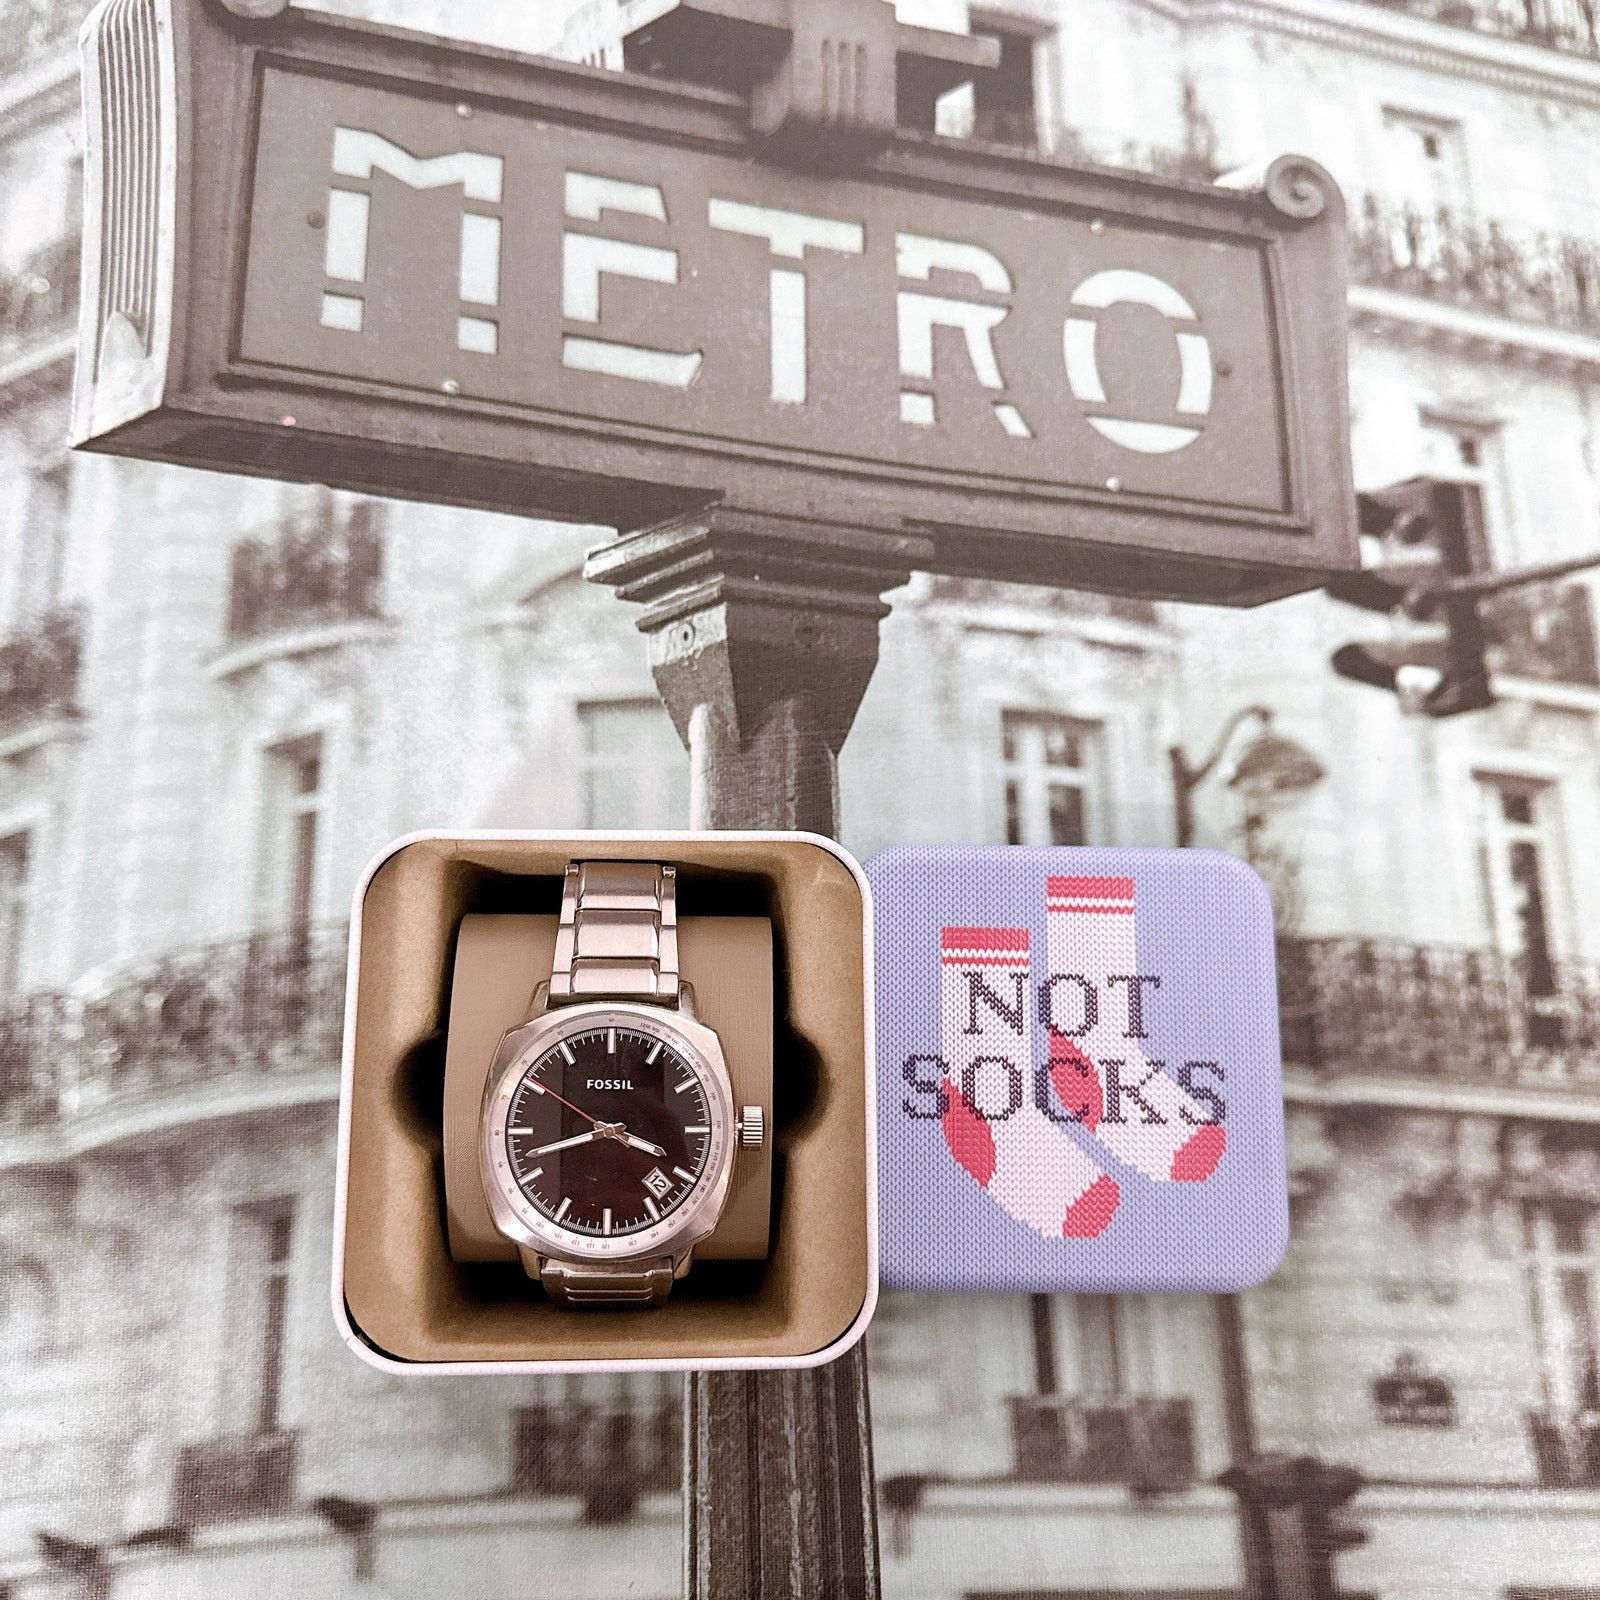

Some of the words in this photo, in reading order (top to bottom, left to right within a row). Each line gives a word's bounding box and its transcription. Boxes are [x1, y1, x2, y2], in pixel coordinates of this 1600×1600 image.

[318, 126, 1214, 454] METRO
[962, 971, 1161, 1038] NOT
[586, 1079, 635, 1090] FOSSIL
[902, 1054, 1227, 1126] SOCKS
[650, 1174, 667, 1193] 12
